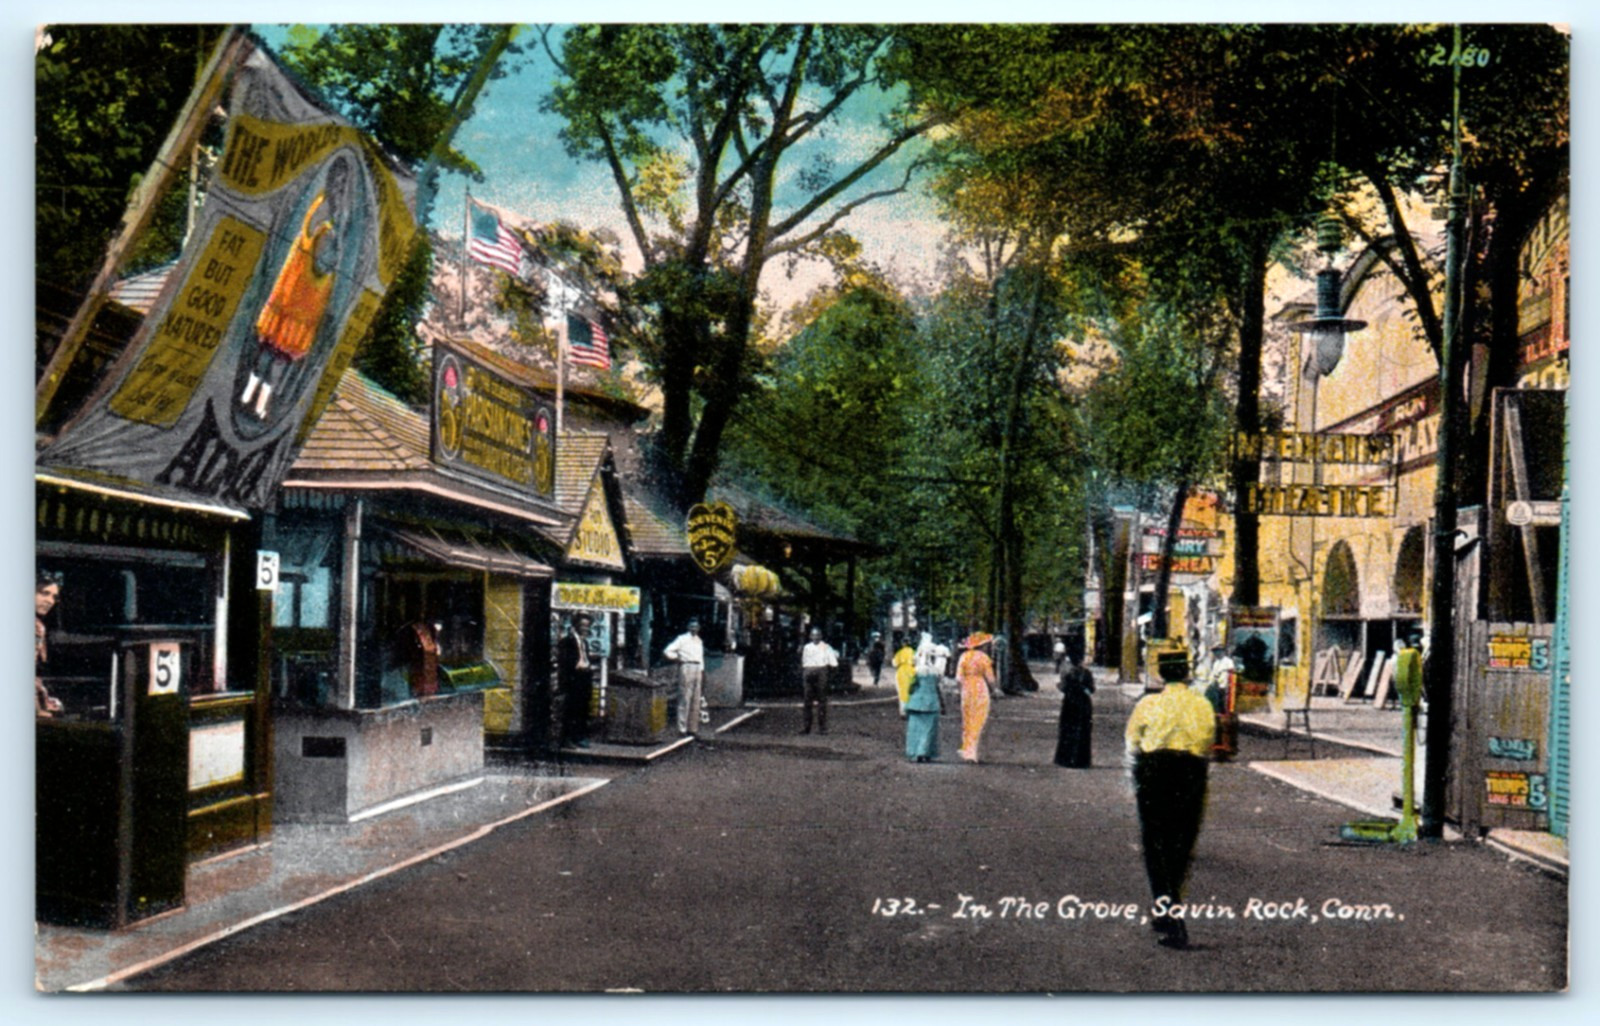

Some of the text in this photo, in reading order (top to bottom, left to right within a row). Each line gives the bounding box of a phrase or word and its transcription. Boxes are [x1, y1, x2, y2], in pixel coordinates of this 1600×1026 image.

[222, 121, 271, 188] THE
[218, 230, 246, 258] FAT
[203, 257, 236, 287] BUT
[186, 286, 227, 318] GOOD
[163, 312, 224, 351] NATURED
[574, 528, 613, 557] STUDIO
[704, 550, 717, 568] 5
[1531, 639, 1548, 670] 5
[1529, 774, 1547, 806] 5
